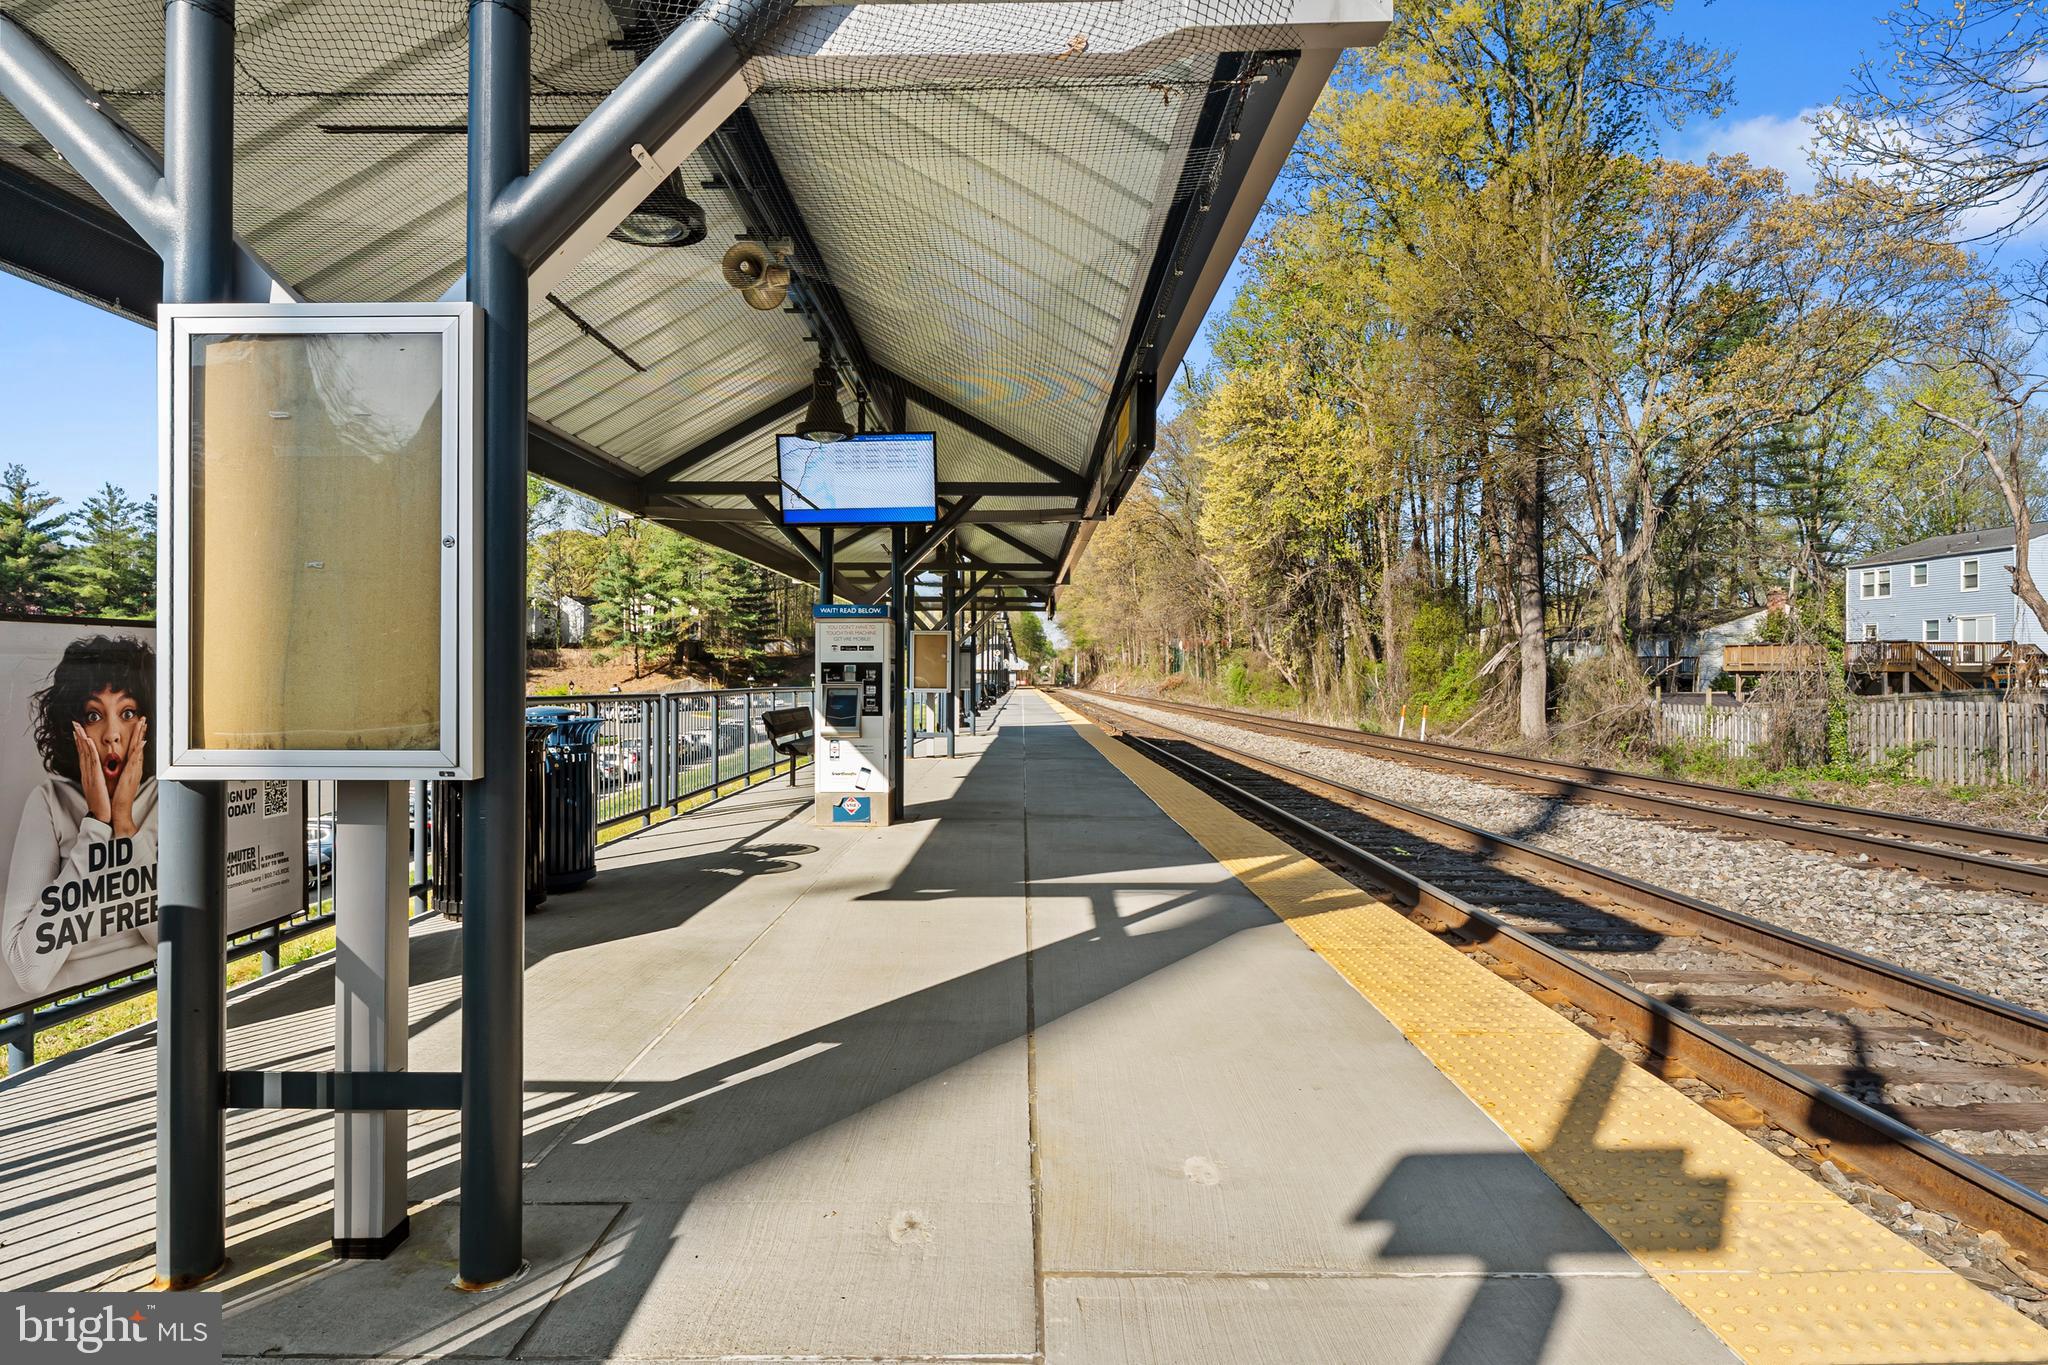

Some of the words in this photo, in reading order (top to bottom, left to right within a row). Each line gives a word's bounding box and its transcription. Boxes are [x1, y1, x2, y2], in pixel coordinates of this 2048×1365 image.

[245, 788, 257, 800] UP
[89, 838, 133, 873] DID
[265, 852, 284, 860] SMARTER
[35, 912, 95, 955] SAY
[100, 895, 158, 937] FREE
